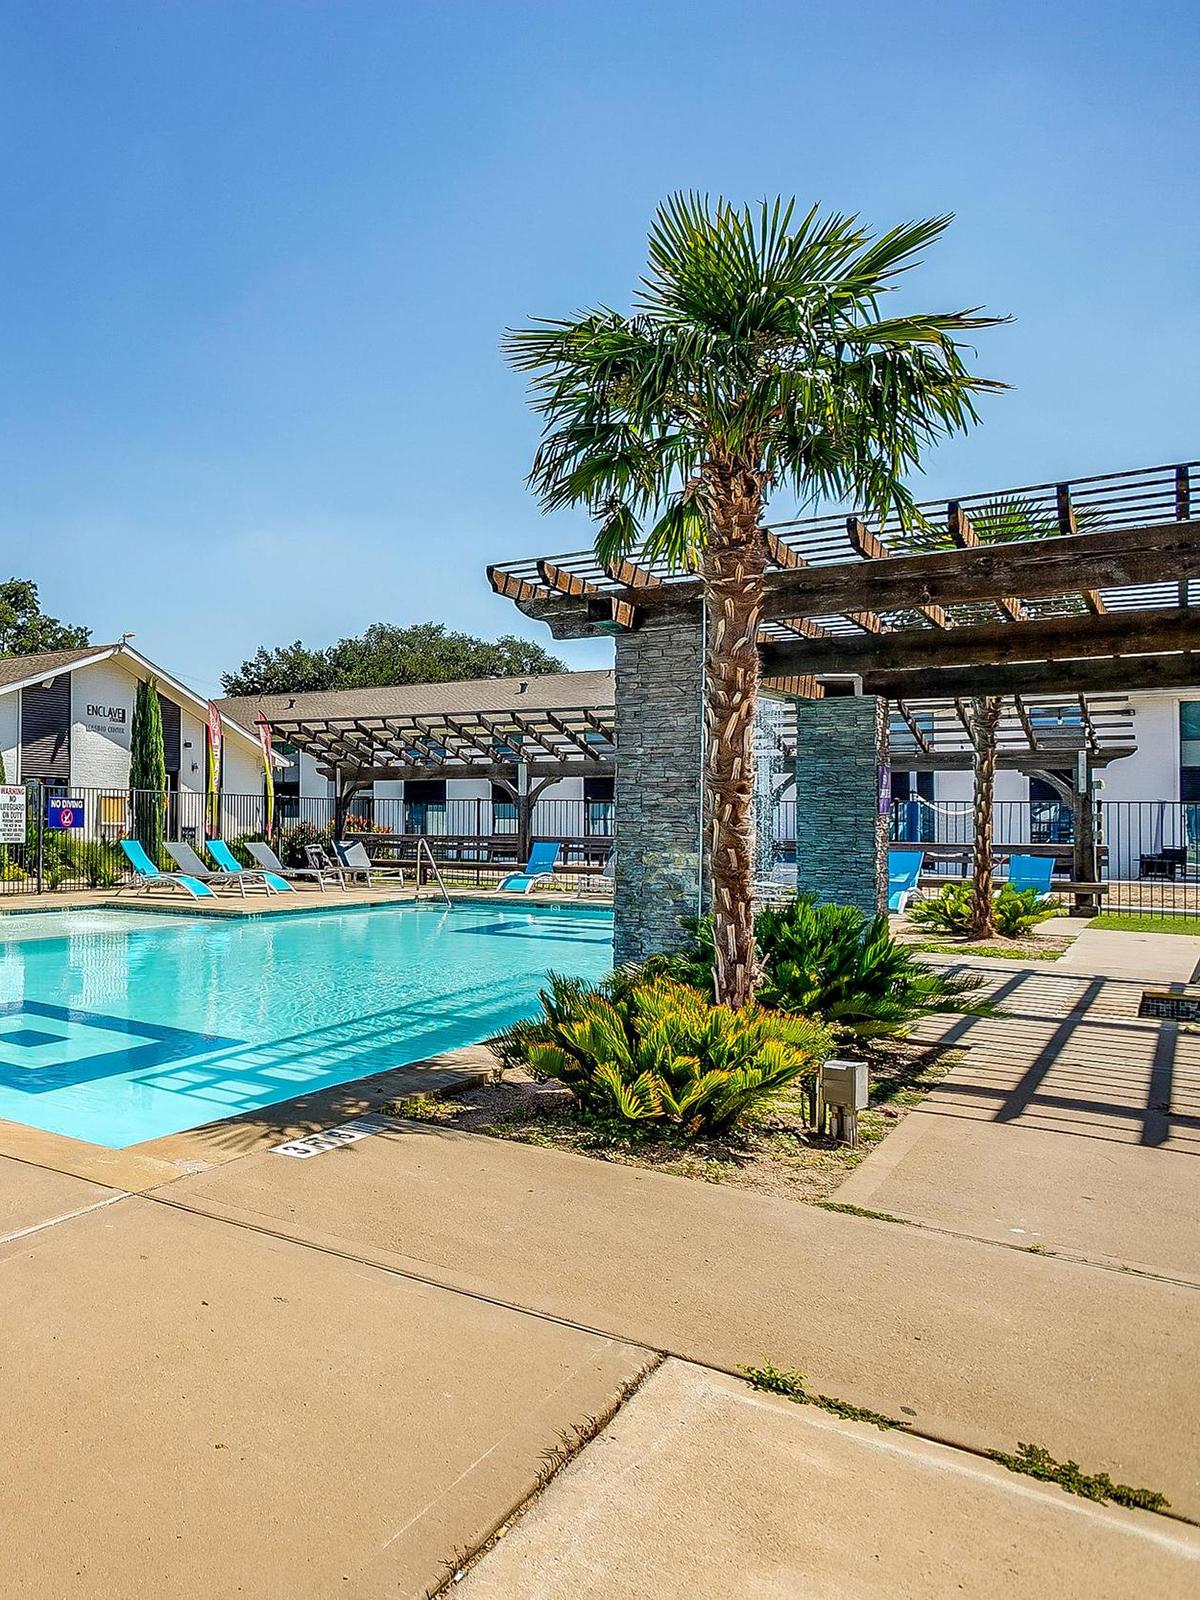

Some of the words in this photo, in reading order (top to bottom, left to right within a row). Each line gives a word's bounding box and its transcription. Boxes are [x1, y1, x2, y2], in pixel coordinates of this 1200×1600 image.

[87, 704, 122, 718] ENCLAVE
[50, 800, 61, 808] NO
[62, 800, 83, 808] DIVING
[282, 1146, 311, 1154] 3
